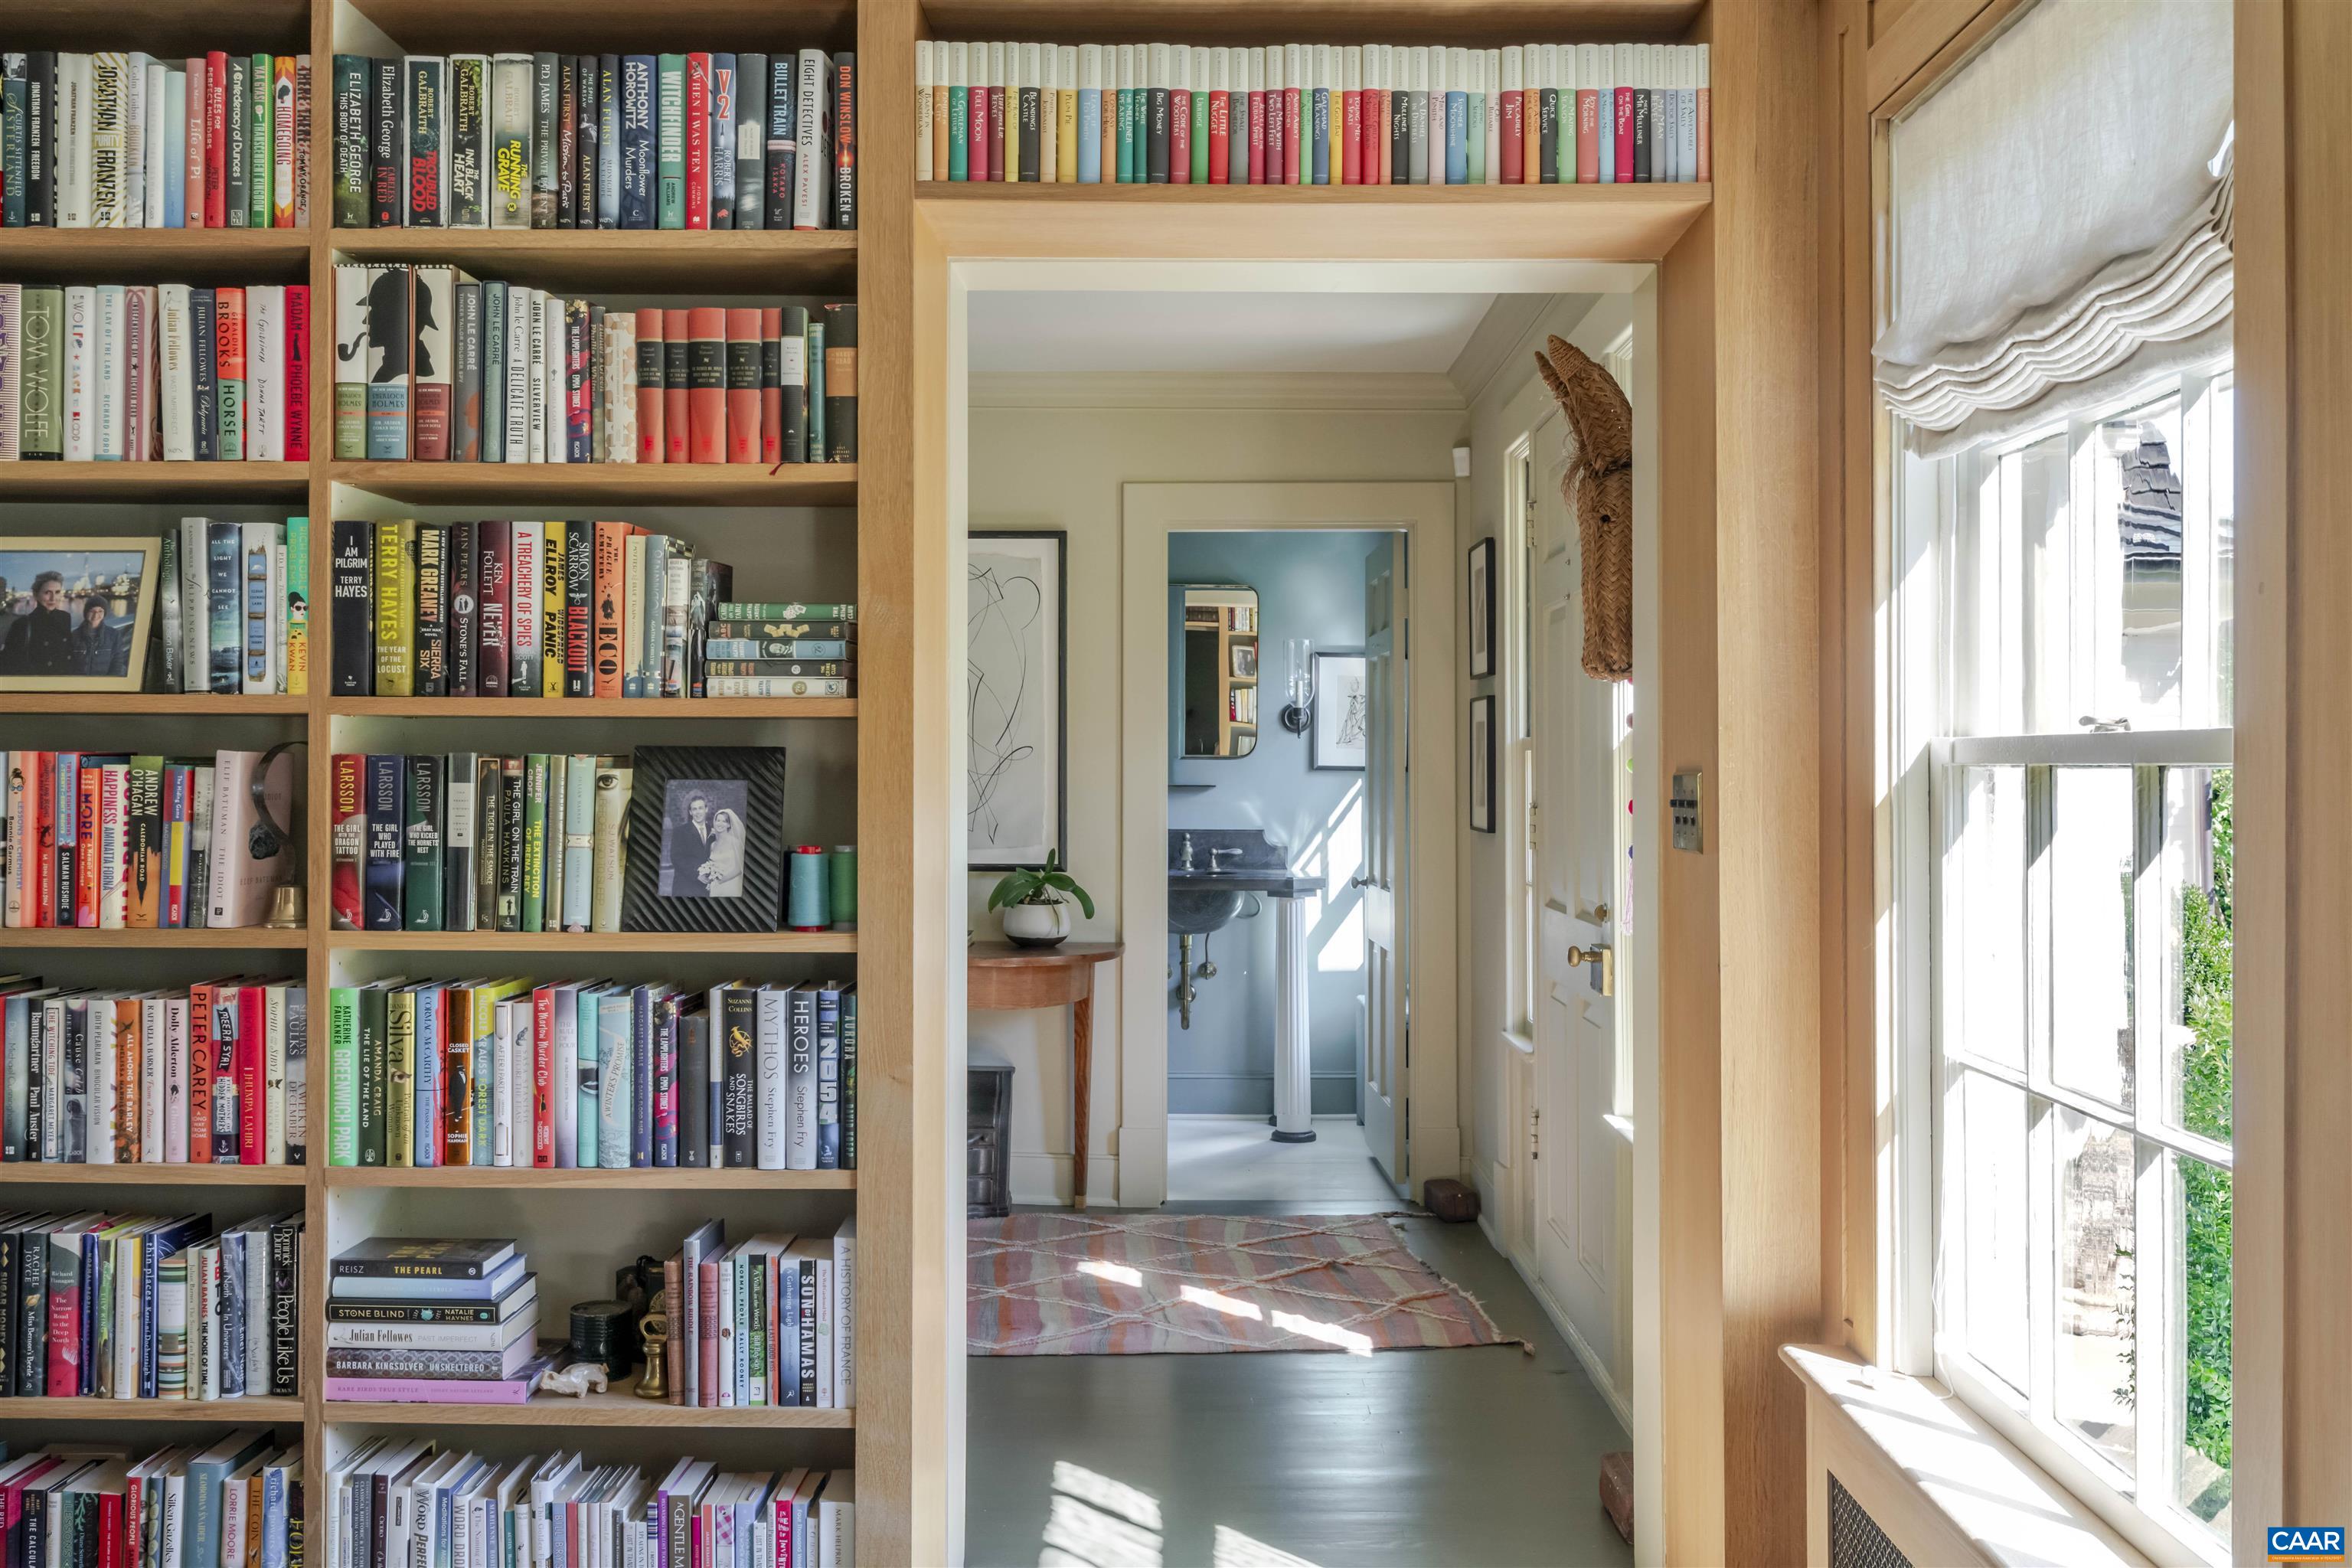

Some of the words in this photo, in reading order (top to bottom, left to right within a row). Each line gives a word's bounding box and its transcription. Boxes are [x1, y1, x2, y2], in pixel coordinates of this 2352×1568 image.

[381, 66, 394, 118] Elizabeth
[774, 63, 787, 102] BULLET
[804, 59, 815, 86] EIGHT
[840, 66, 850, 87] DON
[31, 82, 40, 115] JONATHAN
[350, 73, 361, 139] ELIZABETH
[626, 62, 635, 129] HOROWITZ
[637, 62, 648, 129] ANTHONY
[31, 117, 40, 146] FRANZEN
[276, 106, 291, 165] HOMEGOING
[662, 71, 681, 162] WITCHFINDER
[773, 104, 786, 135] TRAIN
[801, 91, 814, 145] DETECTIVES
[840, 92, 851, 143] WINSLOW
[340, 136, 347, 145] OF
[378, 120, 394, 158] George
[31, 150, 40, 179] FREEDOM
[351, 145, 361, 193] GEORGE
[498, 149, 510, 192] GRAVE
[509, 141, 521, 199] RUNNING
[625, 147, 634, 189] Murders
[639, 140, 649, 196] Moonflower
[841, 167, 851, 211] BROKEN
[291, 292, 302, 330] MADAM
[532, 302, 541, 325] JOHN
[25, 306, 49, 360] TOM
[217, 302, 230, 367] BROOKS
[532, 338, 543, 364] CARRÉ
[571, 336, 580, 370] LAMPLIGHTERS
[24, 370, 48, 438] WOLFE
[291, 364, 302, 406] PHOEBE
[572, 390, 580, 407] STONEX
[223, 386, 236, 436] HORSE
[291, 410, 302, 449] WYNNE
[335, 559, 367, 568] PILGRIM
[345, 547, 358, 557] AM
[381, 524, 398, 579] TERRY
[421, 531, 439, 564] MARK
[568, 532, 578, 590] SCARROW
[579, 543, 589, 580] SIMON
[517, 542, 531, 598] TREACHERY
[546, 539, 557, 596] ELLROY
[335, 586, 367, 597] HAYES
[420, 569, 439, 622] GREANEY
[518, 603, 531, 615] OF
[381, 588, 398, 640] HAYES
[517, 618, 531, 646] SPIES
[545, 612, 556, 658] PANIC
[568, 607, 587, 673] BLACKOUT
[599, 627, 618, 675] ECO
[430, 639, 441, 679] SIERRA
[103, 771, 118, 824] HAPPINESS
[131, 769, 143, 815] O'HAGAN
[144, 770, 158, 815] ANDREW
[340, 761, 354, 812] LARSSON
[378, 763, 393, 810] LARSSON
[416, 763, 430, 812] LARSSON
[512, 780, 521, 799] THE
[103, 827, 115, 864] AMINATTA
[511, 827, 520, 841] ON
[61, 852, 70, 880] SALMAN
[502, 832, 511, 884] HAWKINS
[61, 881, 70, 909] RUSHDIE
[103, 867, 115, 890] FORNA
[511, 865, 519, 893] TRAIN
[169, 1008, 180, 1033] Dolly
[193, 992, 207, 1044] PETER
[538, 998, 547, 1011] The
[334, 1006, 342, 1044] FAULKNER
[538, 1013, 547, 1039] Marlow
[794, 1001, 808, 1073] HEROES
[844, 1015, 855, 1060] AURORA
[171, 1035, 179, 1077] Alderton
[363, 1067, 370, 1079] OF
[373, 1040, 381, 1081] AMANDA
[538, 1042, 547, 1068] Murder
[193, 1050, 207, 1110] CAREY
[538, 1071, 547, 1086] Club
[373, 1086, 381, 1116] CRAIG
[726, 1093, 734, 1132] SNAKES
[736, 1073, 746, 1135] SONGBIRDS
[795, 1086, 807, 1128] Stephen
[747, 1120, 753, 1129] OF
[793, 1132, 806, 1147] Fry
[274, 1233, 284, 1260] Dunne
[281, 1229, 293, 1266] Dominick
[415, 1266, 443, 1275] PEARL
[841, 1258, 851, 1311] HISTORY
[276, 1295, 293, 1335] People
[841, 1315, 851, 1332] OF
[278, 1338, 292, 1364] Like
[336, 1361, 372, 1370] BARBARA
[375, 1362, 423, 1370] KINGSOLVER
[430, 1364, 485, 1372] UNSHELTERED
[841, 1336, 851, 1385] FRANCE
[277, 1367, 292, 1383] Us
[167, 1493, 177, 1520] Silken
[228, 1488, 237, 1521] LORRIE
[165, 1523, 175, 1563] Gazelles
[227, 1524, 237, 1559] MOORE
